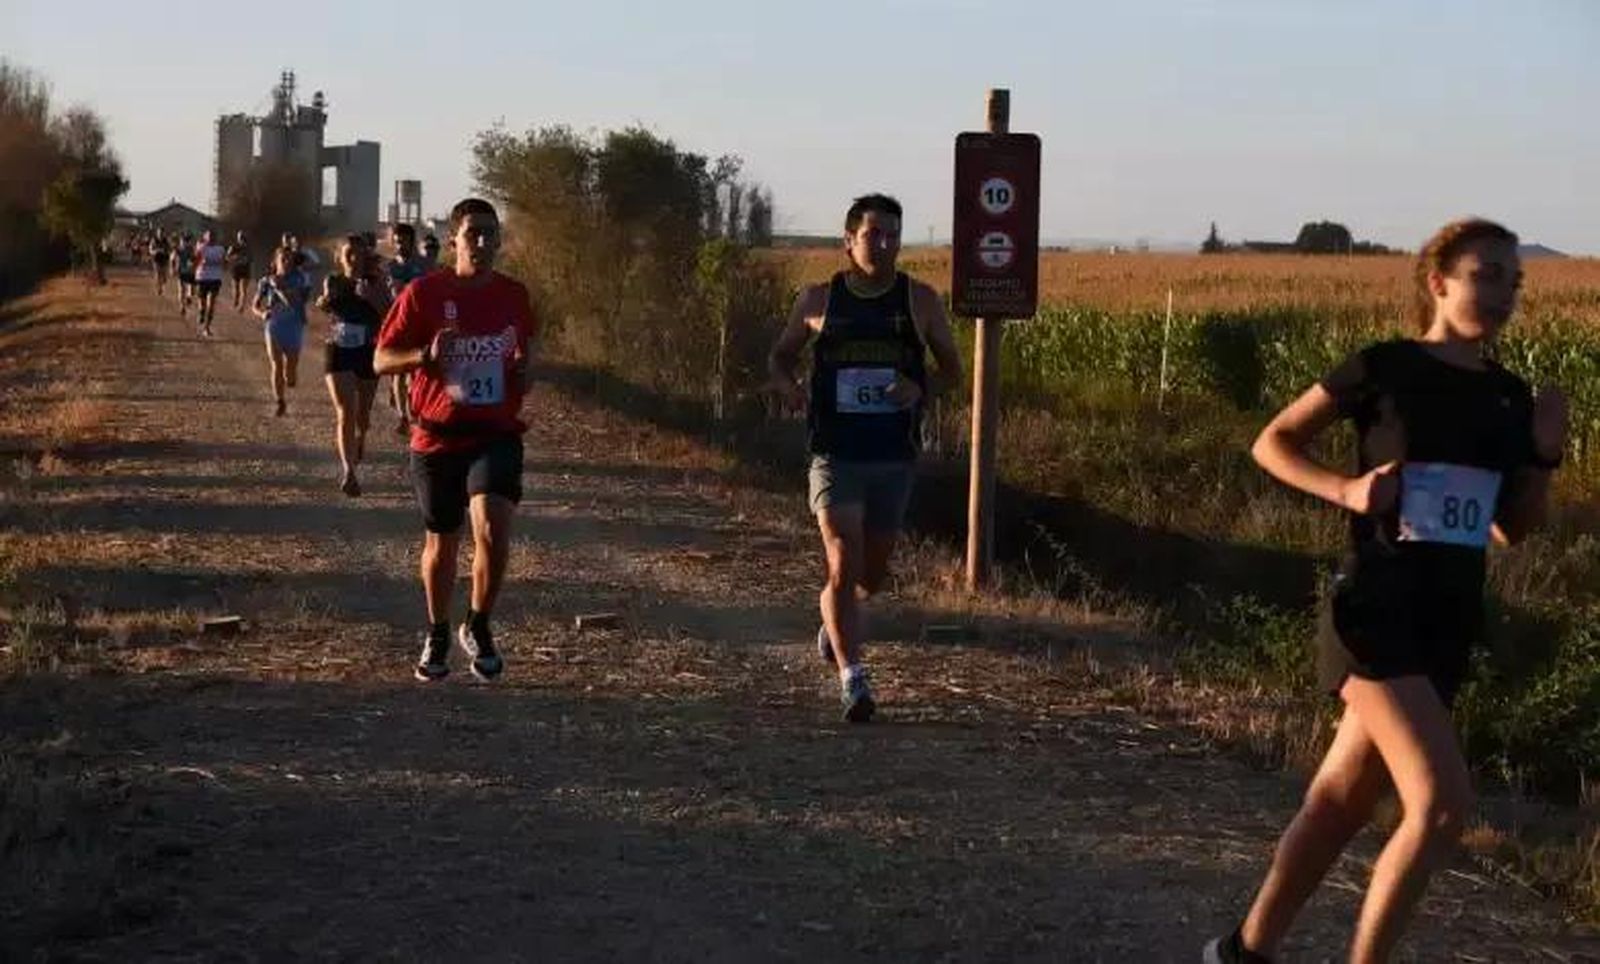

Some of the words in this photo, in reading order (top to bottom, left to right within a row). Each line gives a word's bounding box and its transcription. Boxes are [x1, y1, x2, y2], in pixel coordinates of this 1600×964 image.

[984, 188, 1009, 205] 10
[469, 377, 494, 398] 21
[857, 386, 886, 405] 63
[1442, 495, 1481, 532] 80
